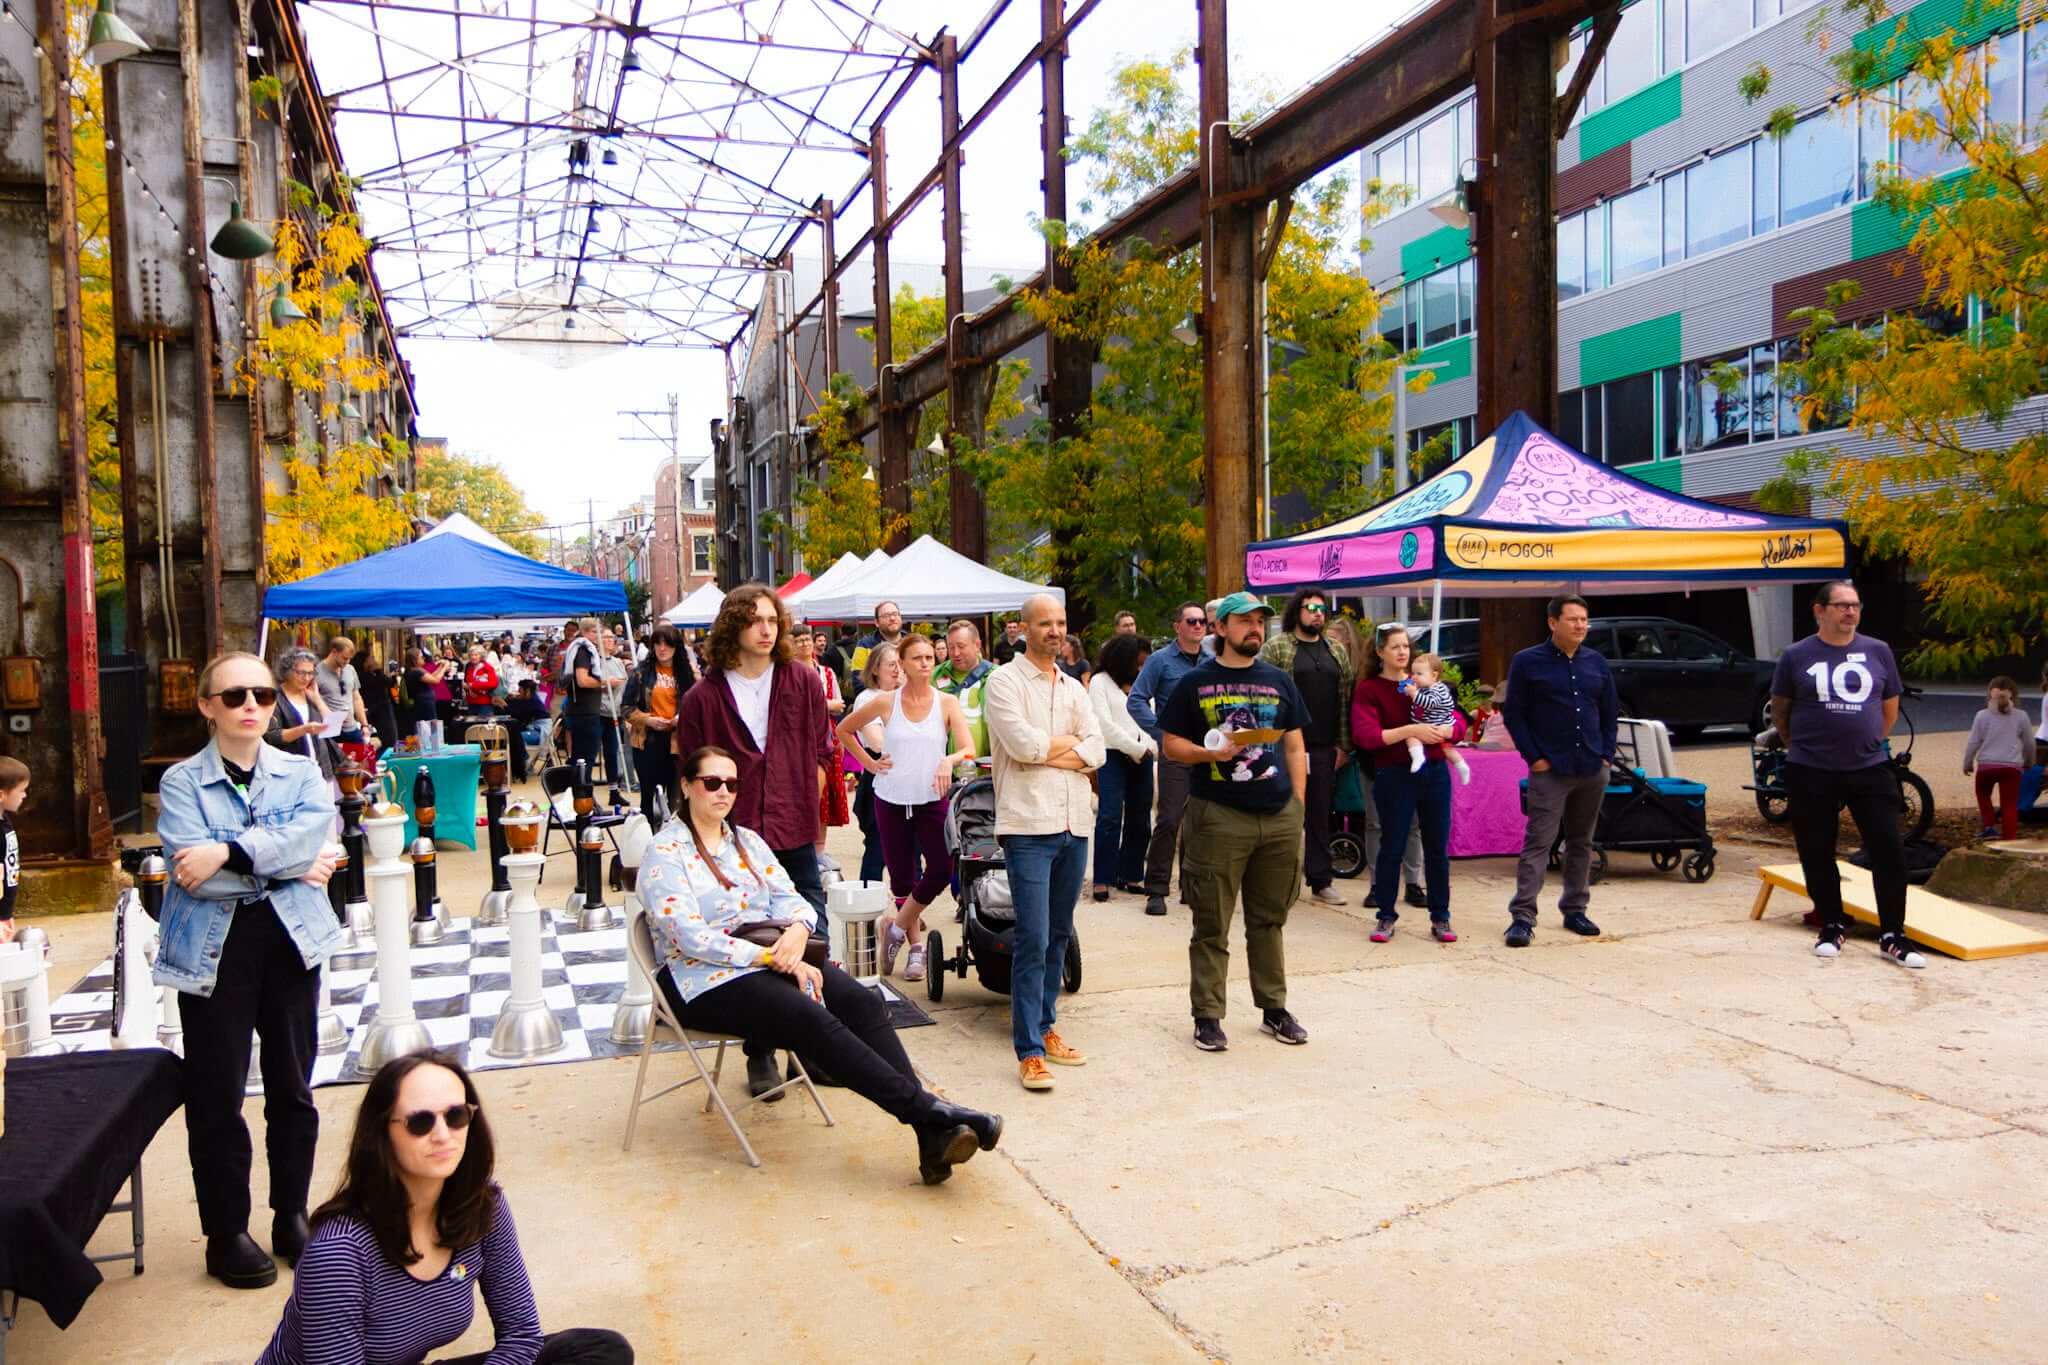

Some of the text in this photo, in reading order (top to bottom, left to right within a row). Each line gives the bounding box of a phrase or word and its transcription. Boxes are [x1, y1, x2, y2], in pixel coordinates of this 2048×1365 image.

[1533, 452, 1564, 463] BIKE
[1524, 489, 1637, 507] POGOH
[1462, 541, 1482, 550] BIKE
[1500, 543, 1553, 558] POGOH
[1806, 661, 1873, 703] 10
